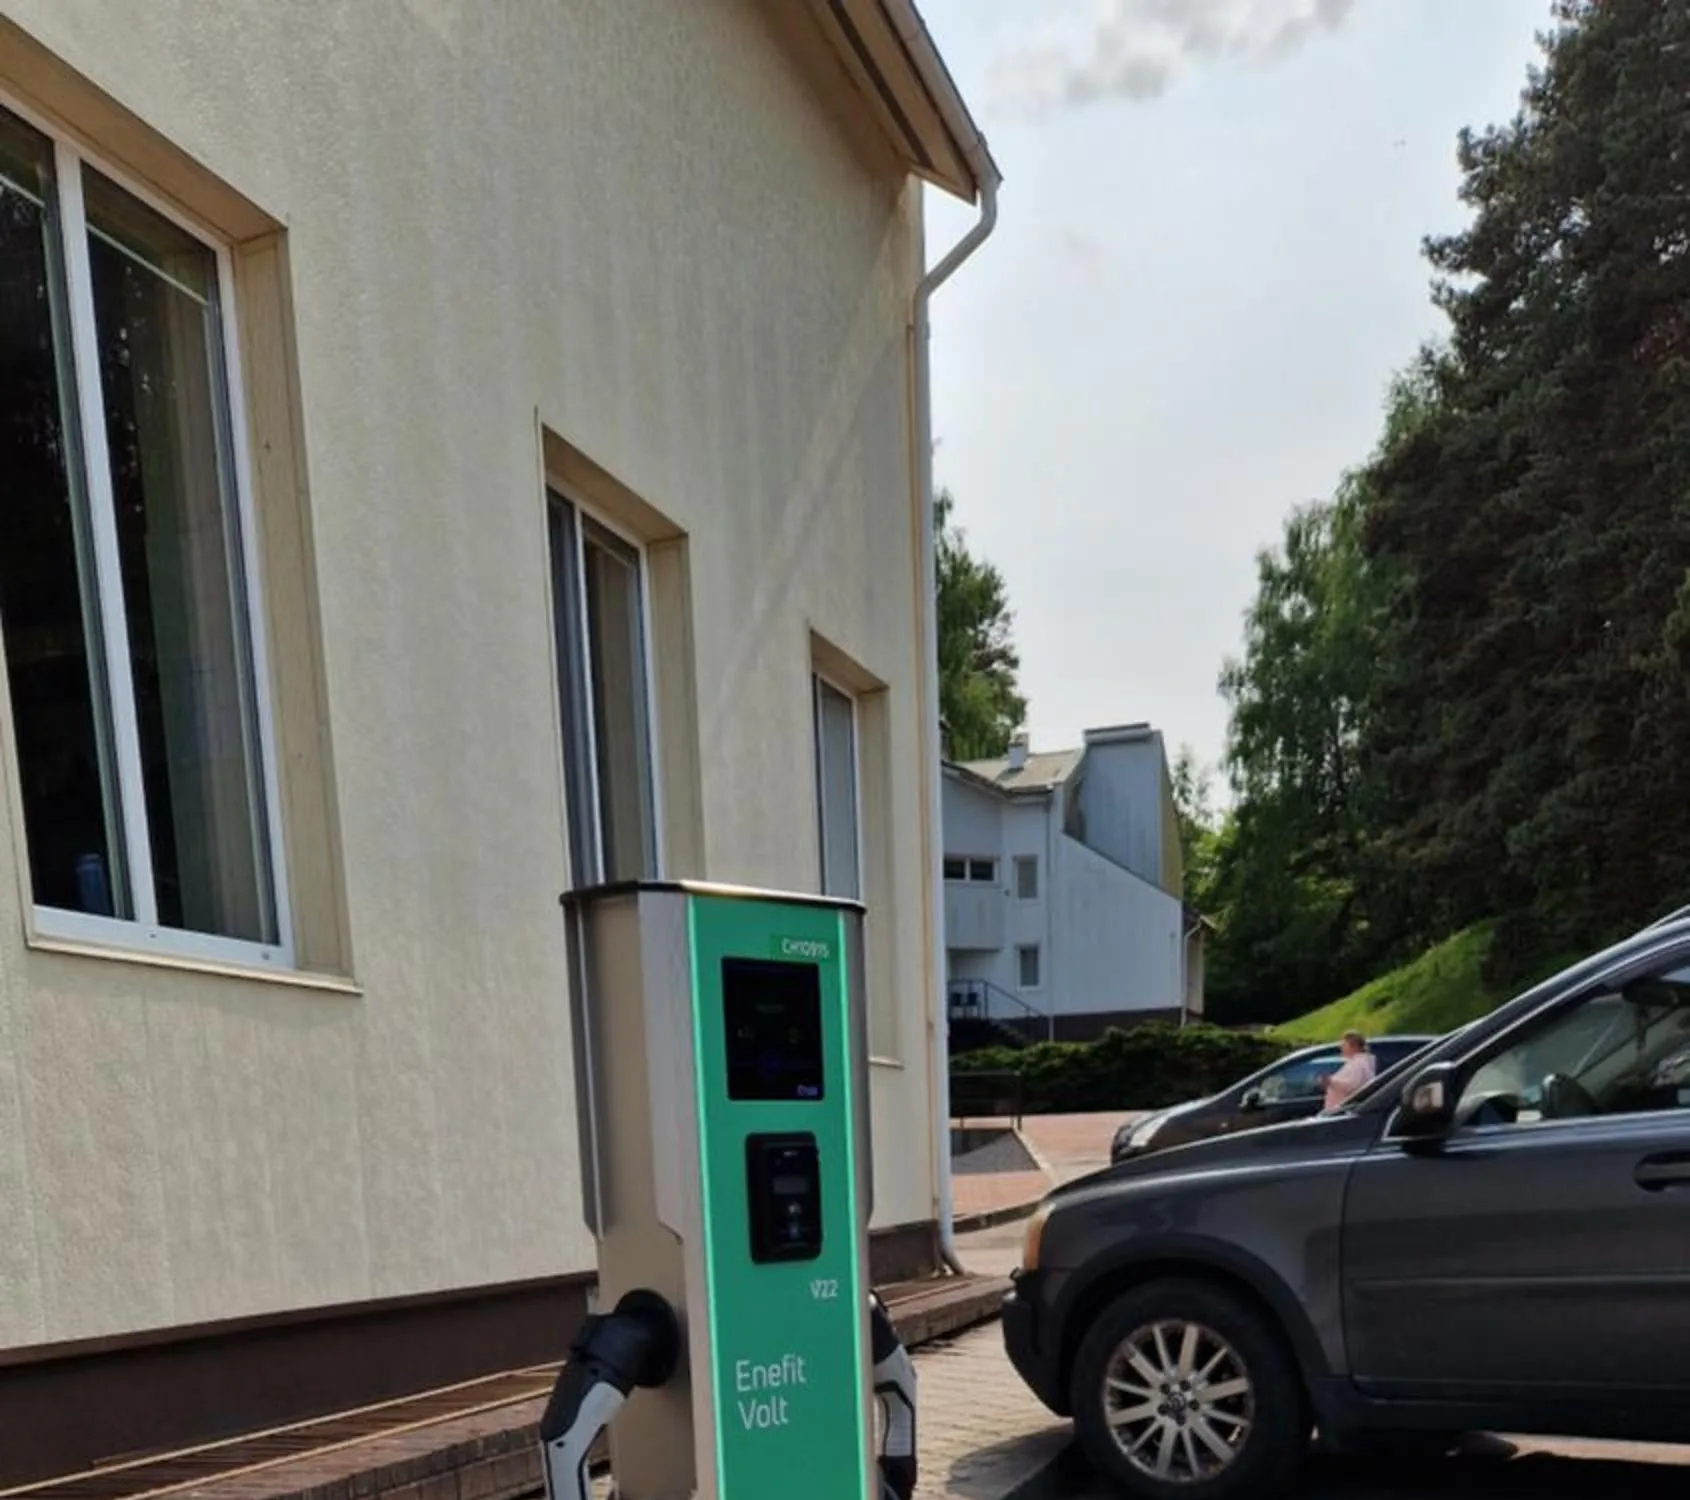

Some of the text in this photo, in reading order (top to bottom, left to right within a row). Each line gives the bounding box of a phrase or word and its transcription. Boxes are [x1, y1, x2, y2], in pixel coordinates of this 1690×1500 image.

[810, 1279, 839, 1299] V22
[735, 1353, 807, 1392] Enefit
[737, 1395, 789, 1430] Volt
